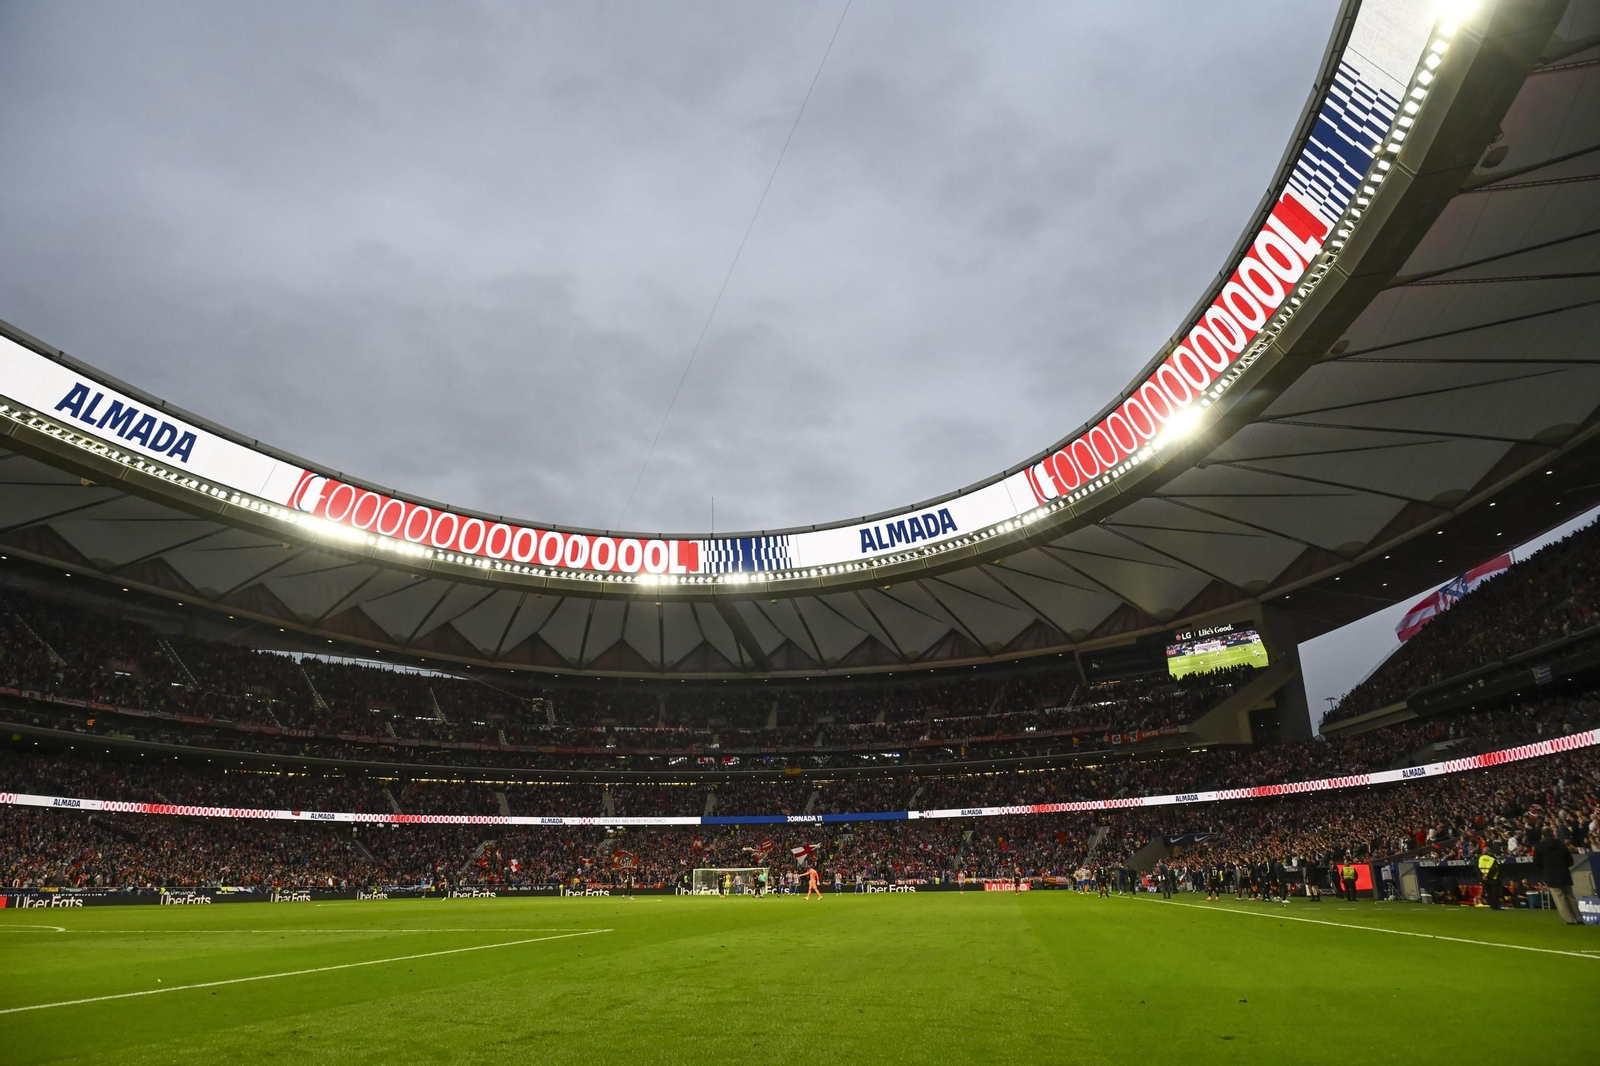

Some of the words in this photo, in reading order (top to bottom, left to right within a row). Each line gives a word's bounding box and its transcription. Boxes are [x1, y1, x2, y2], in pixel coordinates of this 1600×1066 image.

[55, 382, 197, 463] ALMADA
[860, 508, 958, 553] ALMADA
[1181, 631, 1192, 640] LG
[1402, 767, 1426, 779] ALMADA
[53, 798, 81, 808] ALMADA
[1175, 794, 1199, 803] ALMADA
[560, 888, 585, 897] Uber
[585, 888, 610, 896] Eats
[889, 884, 916, 892] Eats
[15, 896, 49, 908] Uber
[51, 896, 83, 908] Eats
[161, 895, 186, 905] Uber
[187, 895, 211, 905] Eats
[291, 893, 311, 902] Eats
